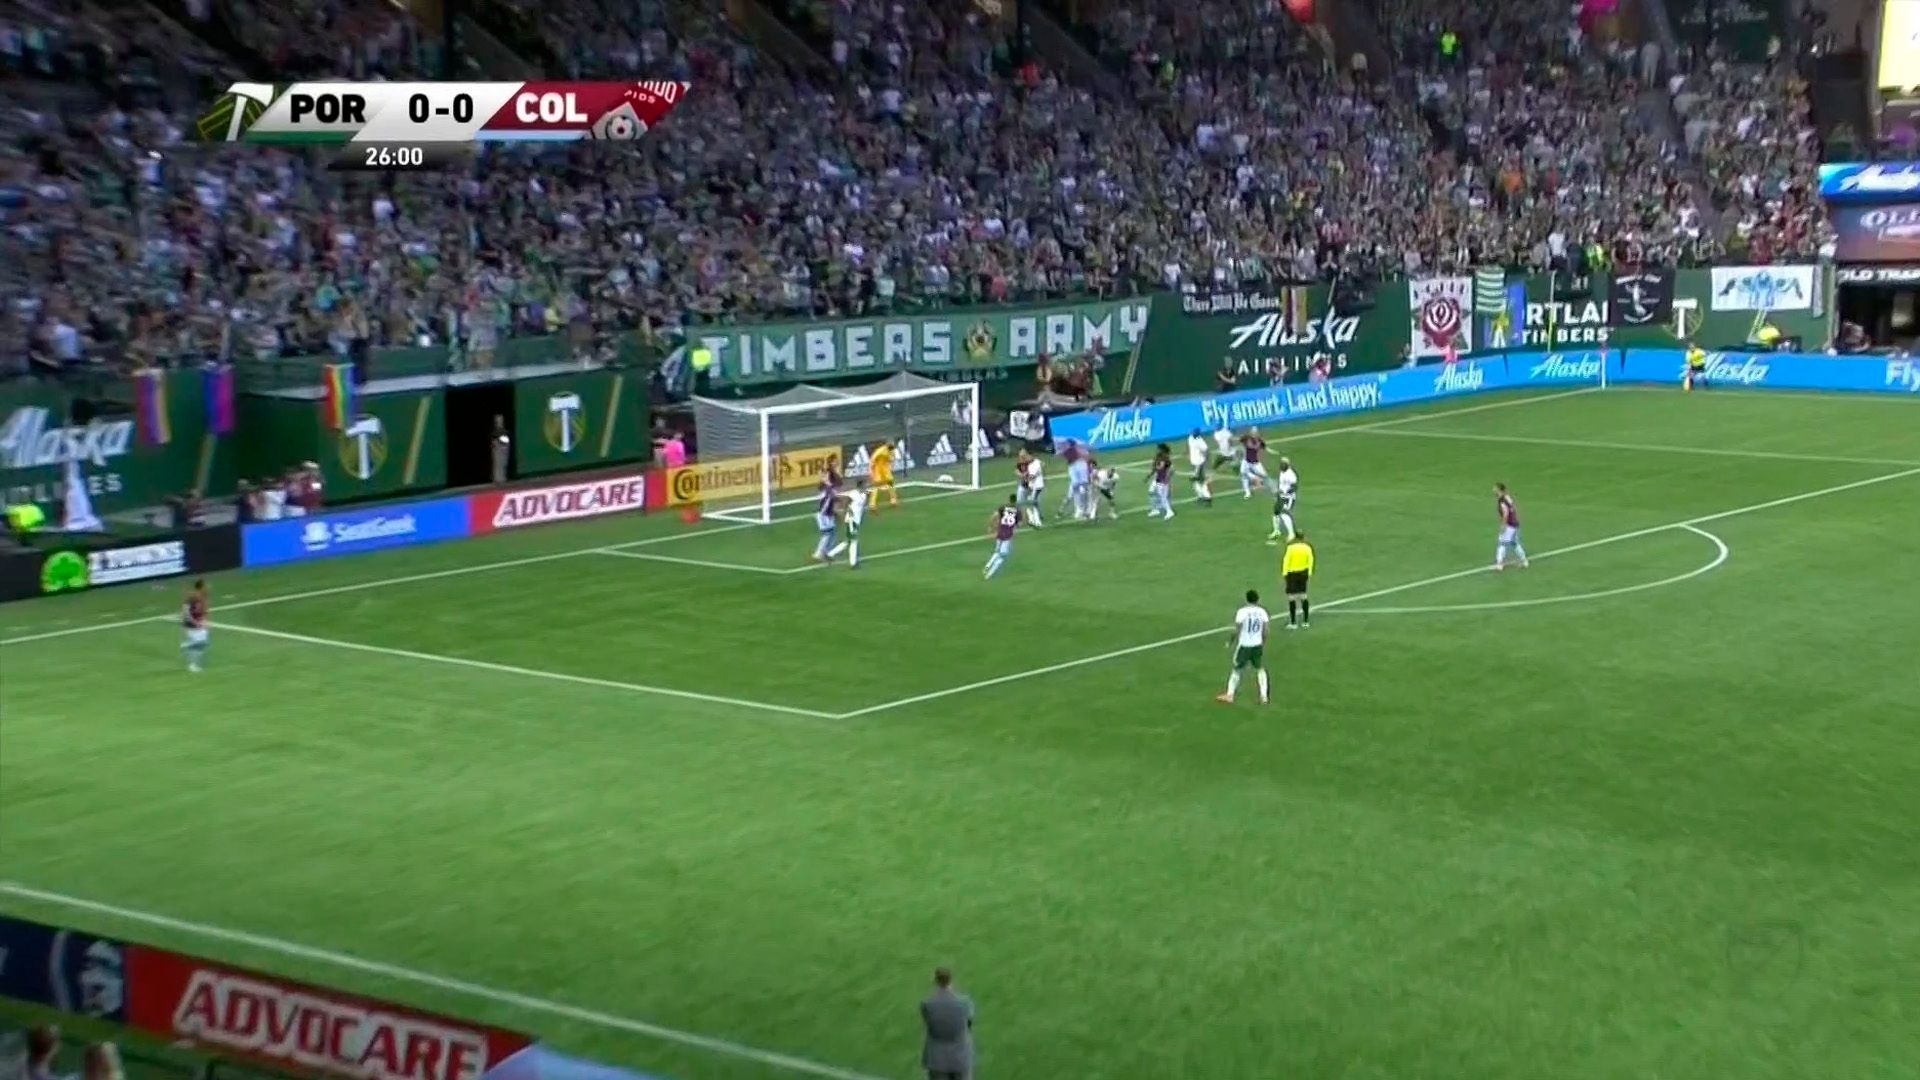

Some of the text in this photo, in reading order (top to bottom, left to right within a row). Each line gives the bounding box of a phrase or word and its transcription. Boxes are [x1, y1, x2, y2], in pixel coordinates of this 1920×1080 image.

[700, 304, 1149, 379] TIMBERS ARMY
[1530, 353, 1601, 379] Alaska
[1088, 407, 1152, 445] Alaska
[1202, 399, 1229, 429] Fly
[1286, 388, 1327, 411] Land
[496, 475, 644, 528] ADVOCARE
[173, 968, 490, 1080] ADVOCARE
